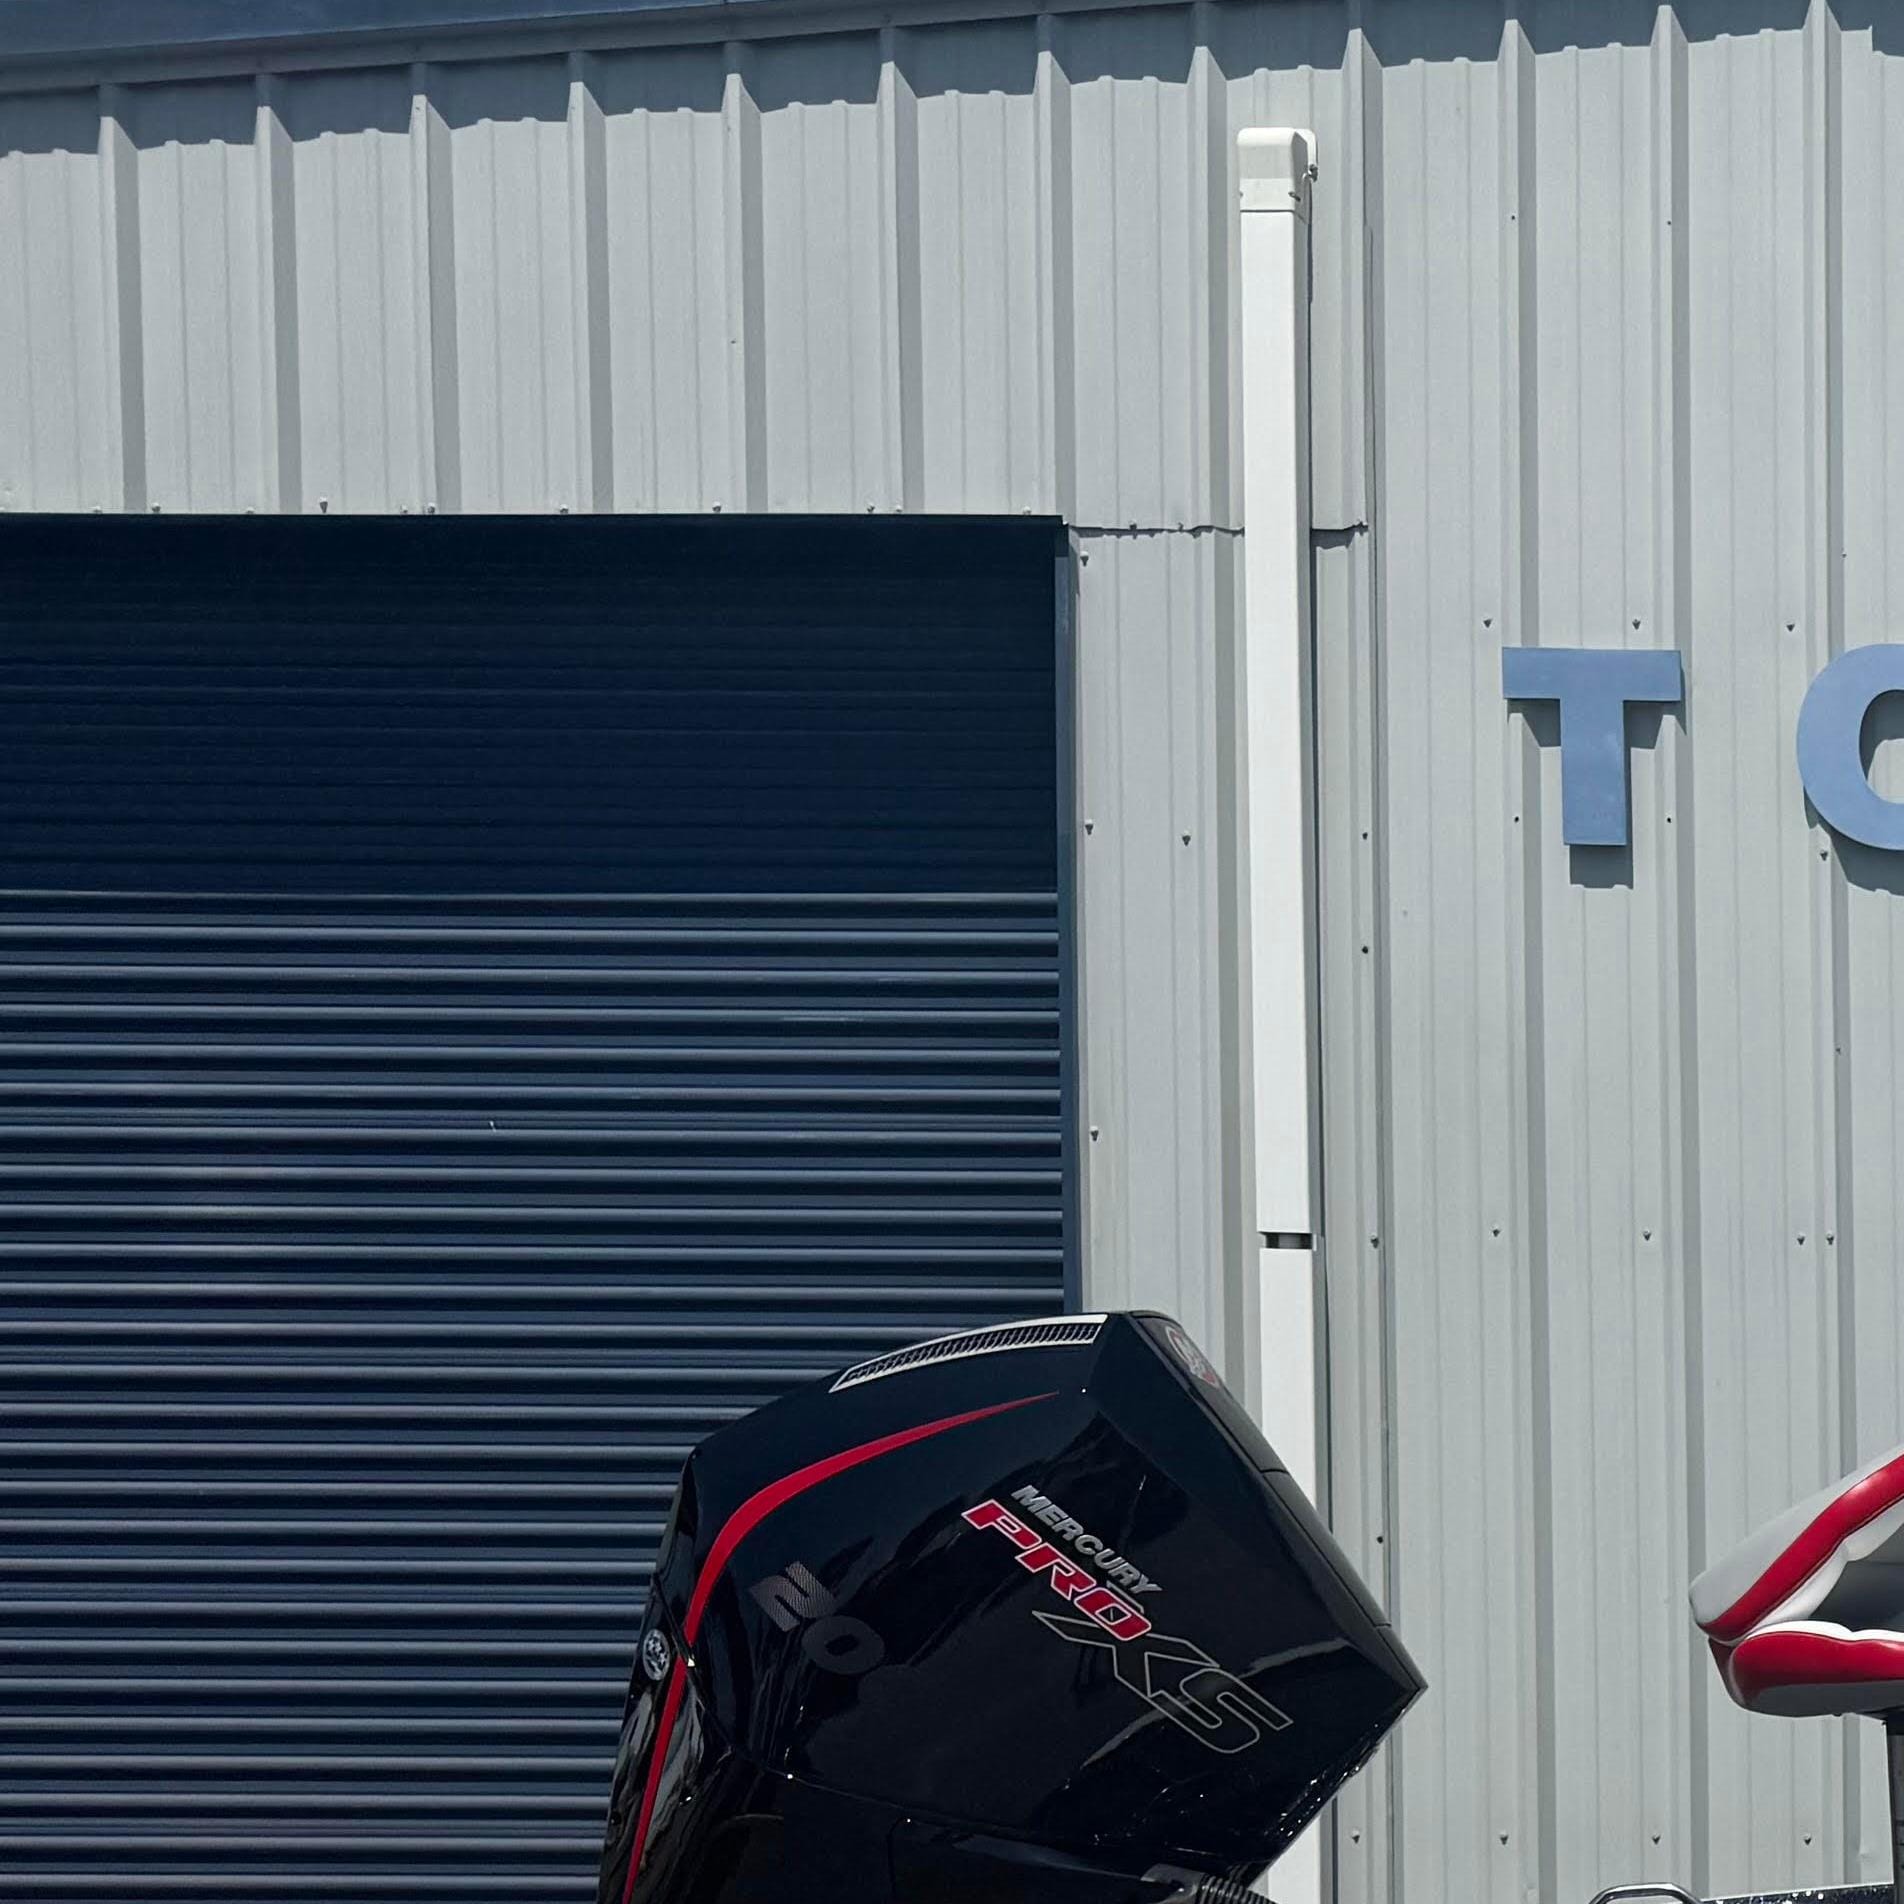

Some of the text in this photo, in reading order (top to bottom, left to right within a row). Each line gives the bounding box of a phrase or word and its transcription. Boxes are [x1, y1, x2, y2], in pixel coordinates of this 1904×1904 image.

[961, 1499, 1152, 1641] PRO
[1011, 1485, 1162, 1594] MERCURY
[1032, 1580, 1294, 1754] XS
